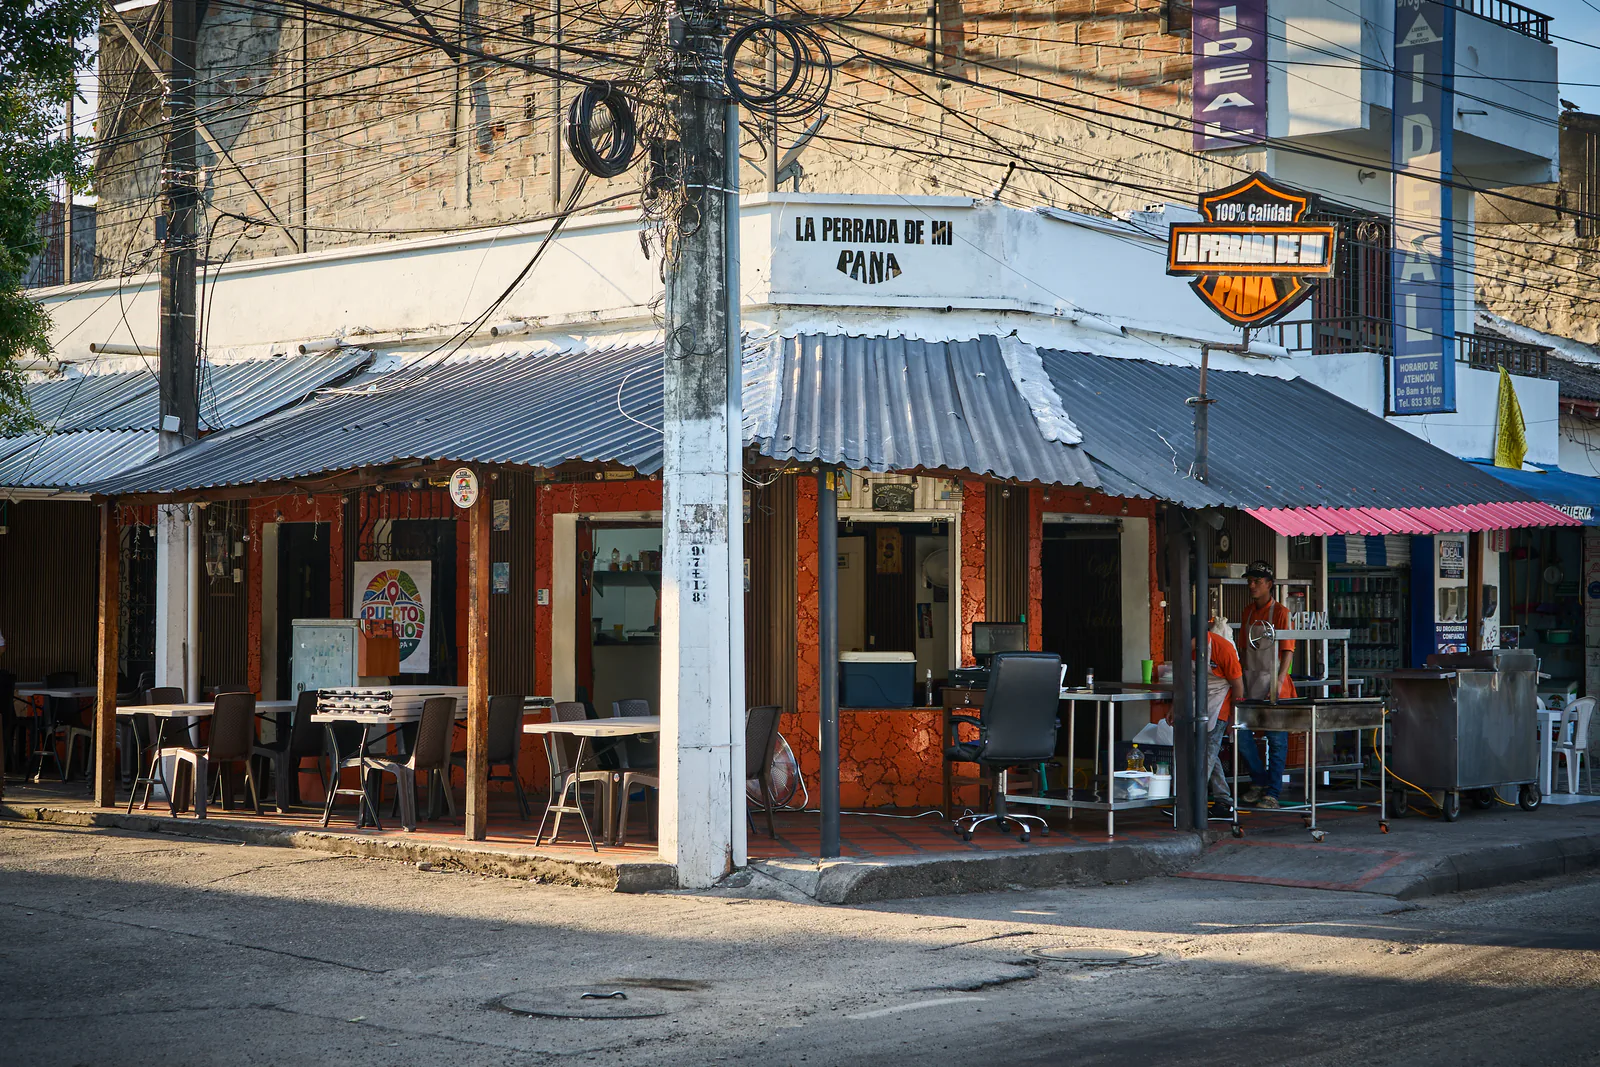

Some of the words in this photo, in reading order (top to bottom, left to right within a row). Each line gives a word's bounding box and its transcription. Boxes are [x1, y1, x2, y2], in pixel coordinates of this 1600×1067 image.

[1202, 5, 1255, 140] IDEAL
[1400, 53, 1436, 343] IDEAL
[1215, 203, 1245, 222] 100%
[1247, 203, 1293, 222] Calidad
[795, 217, 816, 242] LA
[822, 217, 899, 244] PERRADA
[904, 219, 925, 245] DE
[931, 220, 953, 246] MI
[1177, 233, 1199, 263] LA
[1199, 234, 1276, 264] PERRADA
[1276, 234, 1300, 264] DE
[836, 249, 903, 285] PANA
[1212, 275, 1279, 316] PANA
[1399, 362, 1429, 373] HORARIO
[1429, 361, 1439, 370] DE
[1403, 372, 1435, 384] ATENCIÓN
[1396, 387, 1405, 396] De
[1405, 386, 1419, 396] 8am
[1425, 385, 1443, 396] 11pm
[1399, 399, 1410, 408] Tel.
[1411, 397, 1423, 407] 833
[1423, 397, 1432, 406] 38
[1432, 396, 1441, 406] 62
[1442, 547, 1462, 558] IDEAL
[366, 605, 419, 622] PUERTO
[1288, 611, 1301, 630] MI
[1302, 611, 1331, 630] PANA
[394, 621, 416, 638] RÍO
